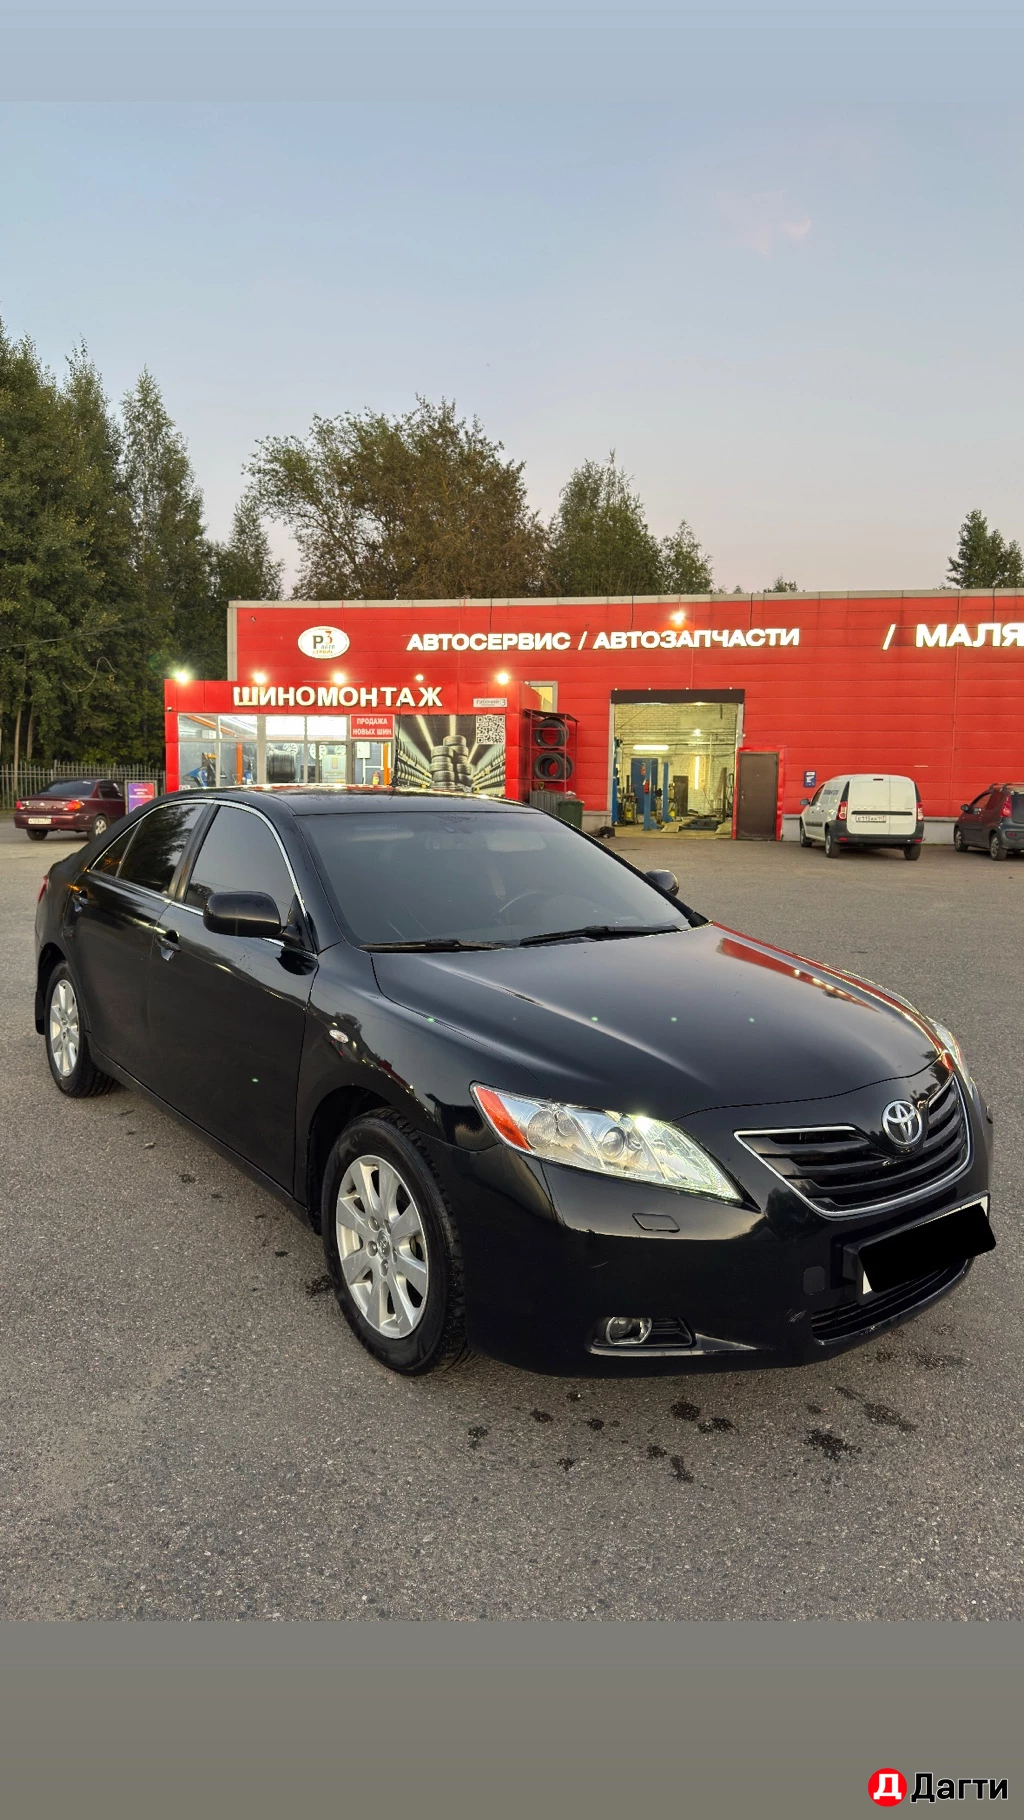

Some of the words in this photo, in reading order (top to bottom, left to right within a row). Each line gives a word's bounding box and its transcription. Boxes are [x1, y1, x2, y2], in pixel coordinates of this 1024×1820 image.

[406, 632, 571, 651] АВТОСЕРВИС
[577, 631, 588, 650] /
[592, 628, 800, 650] АВТОЗАПЧАСТИ
[882, 623, 897, 651] /
[915, 622, 1024, 648] МАЛЯ
[233, 686, 443, 708] ШИНОМОНТАЖ
[501, 698, 507, 707] 3
[356, 717, 388, 726] ПРОДАЖА
[352, 728, 376, 736] НОВЫХ
[376, 728, 392, 736] ШИН
